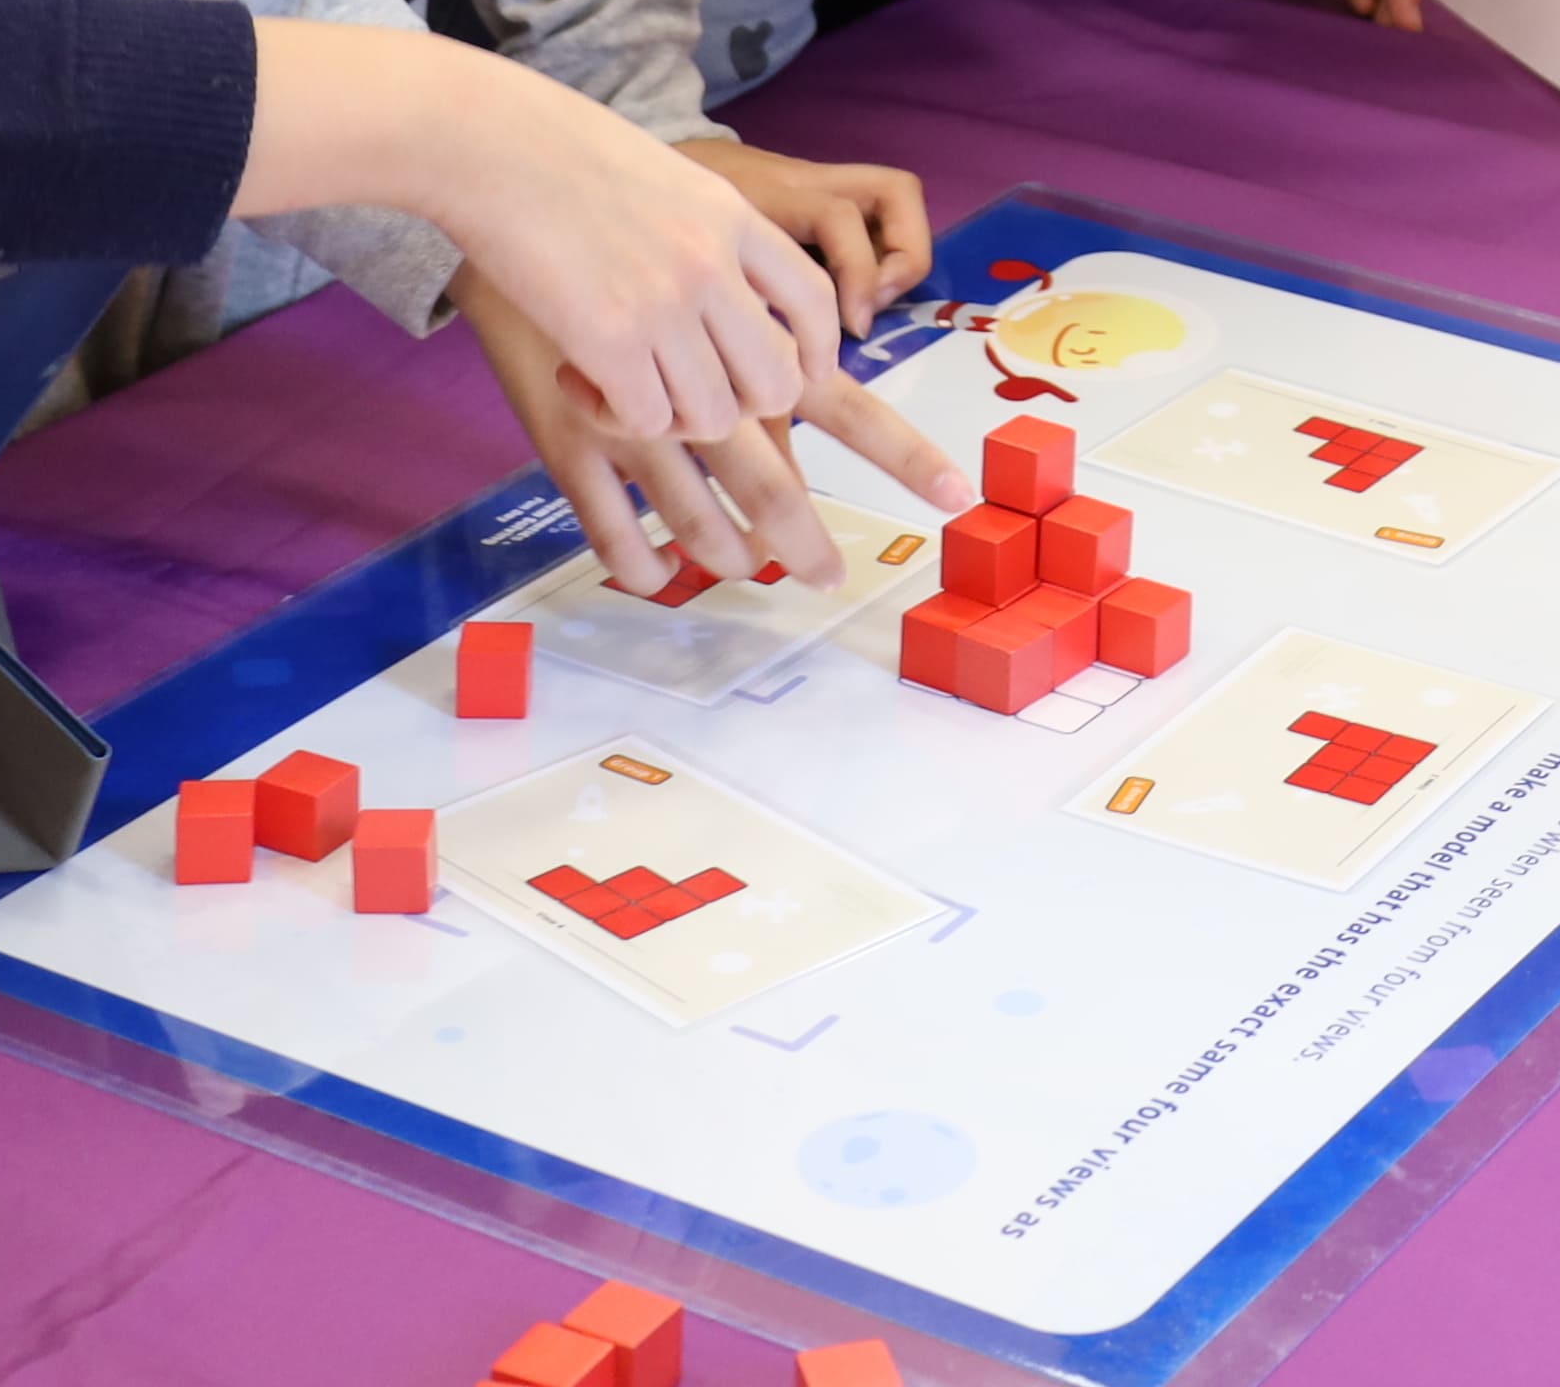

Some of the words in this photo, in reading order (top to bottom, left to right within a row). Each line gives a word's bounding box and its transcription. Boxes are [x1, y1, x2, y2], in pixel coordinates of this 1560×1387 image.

[1488, 800, 1511, 812] a
[1424, 815, 1496, 870] model
[1375, 871, 1434, 910] that
[1457, 878, 1513, 918] seen
[1336, 911, 1391, 944] has
[1407, 921, 1471, 963] from
[1295, 947, 1345, 979] the
[1363, 966, 1421, 1006] four
[1229, 983, 1301, 1037] exact
[1293, 1009, 1368, 1062] views.
[1165, 1039, 1237, 1094] same
[1113, 1098, 1177, 1144] four
[1035, 1148, 1117, 1208] views
[1000, 1211, 1040, 1238] as
